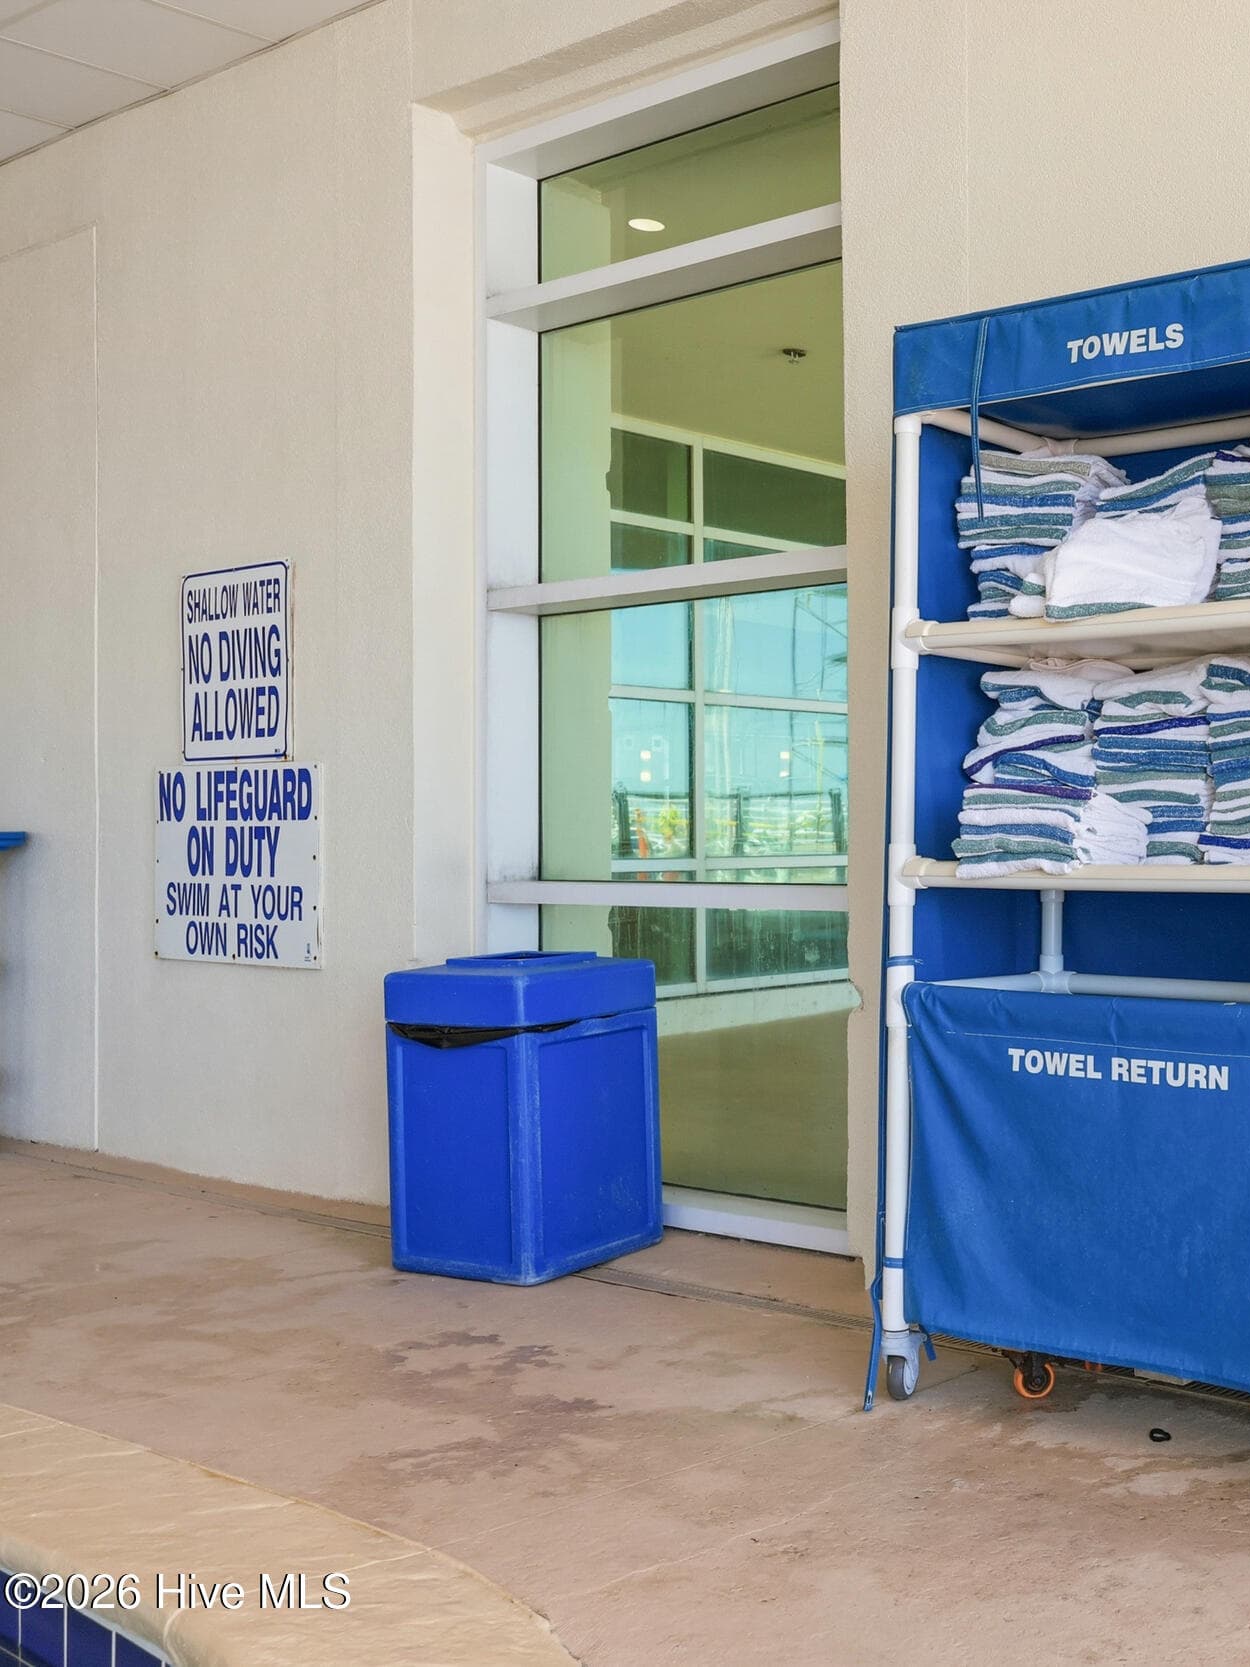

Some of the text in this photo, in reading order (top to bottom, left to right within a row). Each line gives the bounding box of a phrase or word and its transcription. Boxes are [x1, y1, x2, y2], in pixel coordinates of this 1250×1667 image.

[1067, 323, 1184, 363] TOWELS
[187, 578, 281, 625] SHALLOW WATER
[188, 624, 281, 684] NO DIVING
[190, 686, 280, 742] ALLOWED
[159, 768, 313, 823] NO LIFEGUARD
[187, 825, 280, 878] ON DUTY
[166, 881, 304, 922] SWIM AT YOUR
[185, 920, 280, 960] OWN RISK
[1008, 1048, 1229, 1091] TOWEL RETURN
